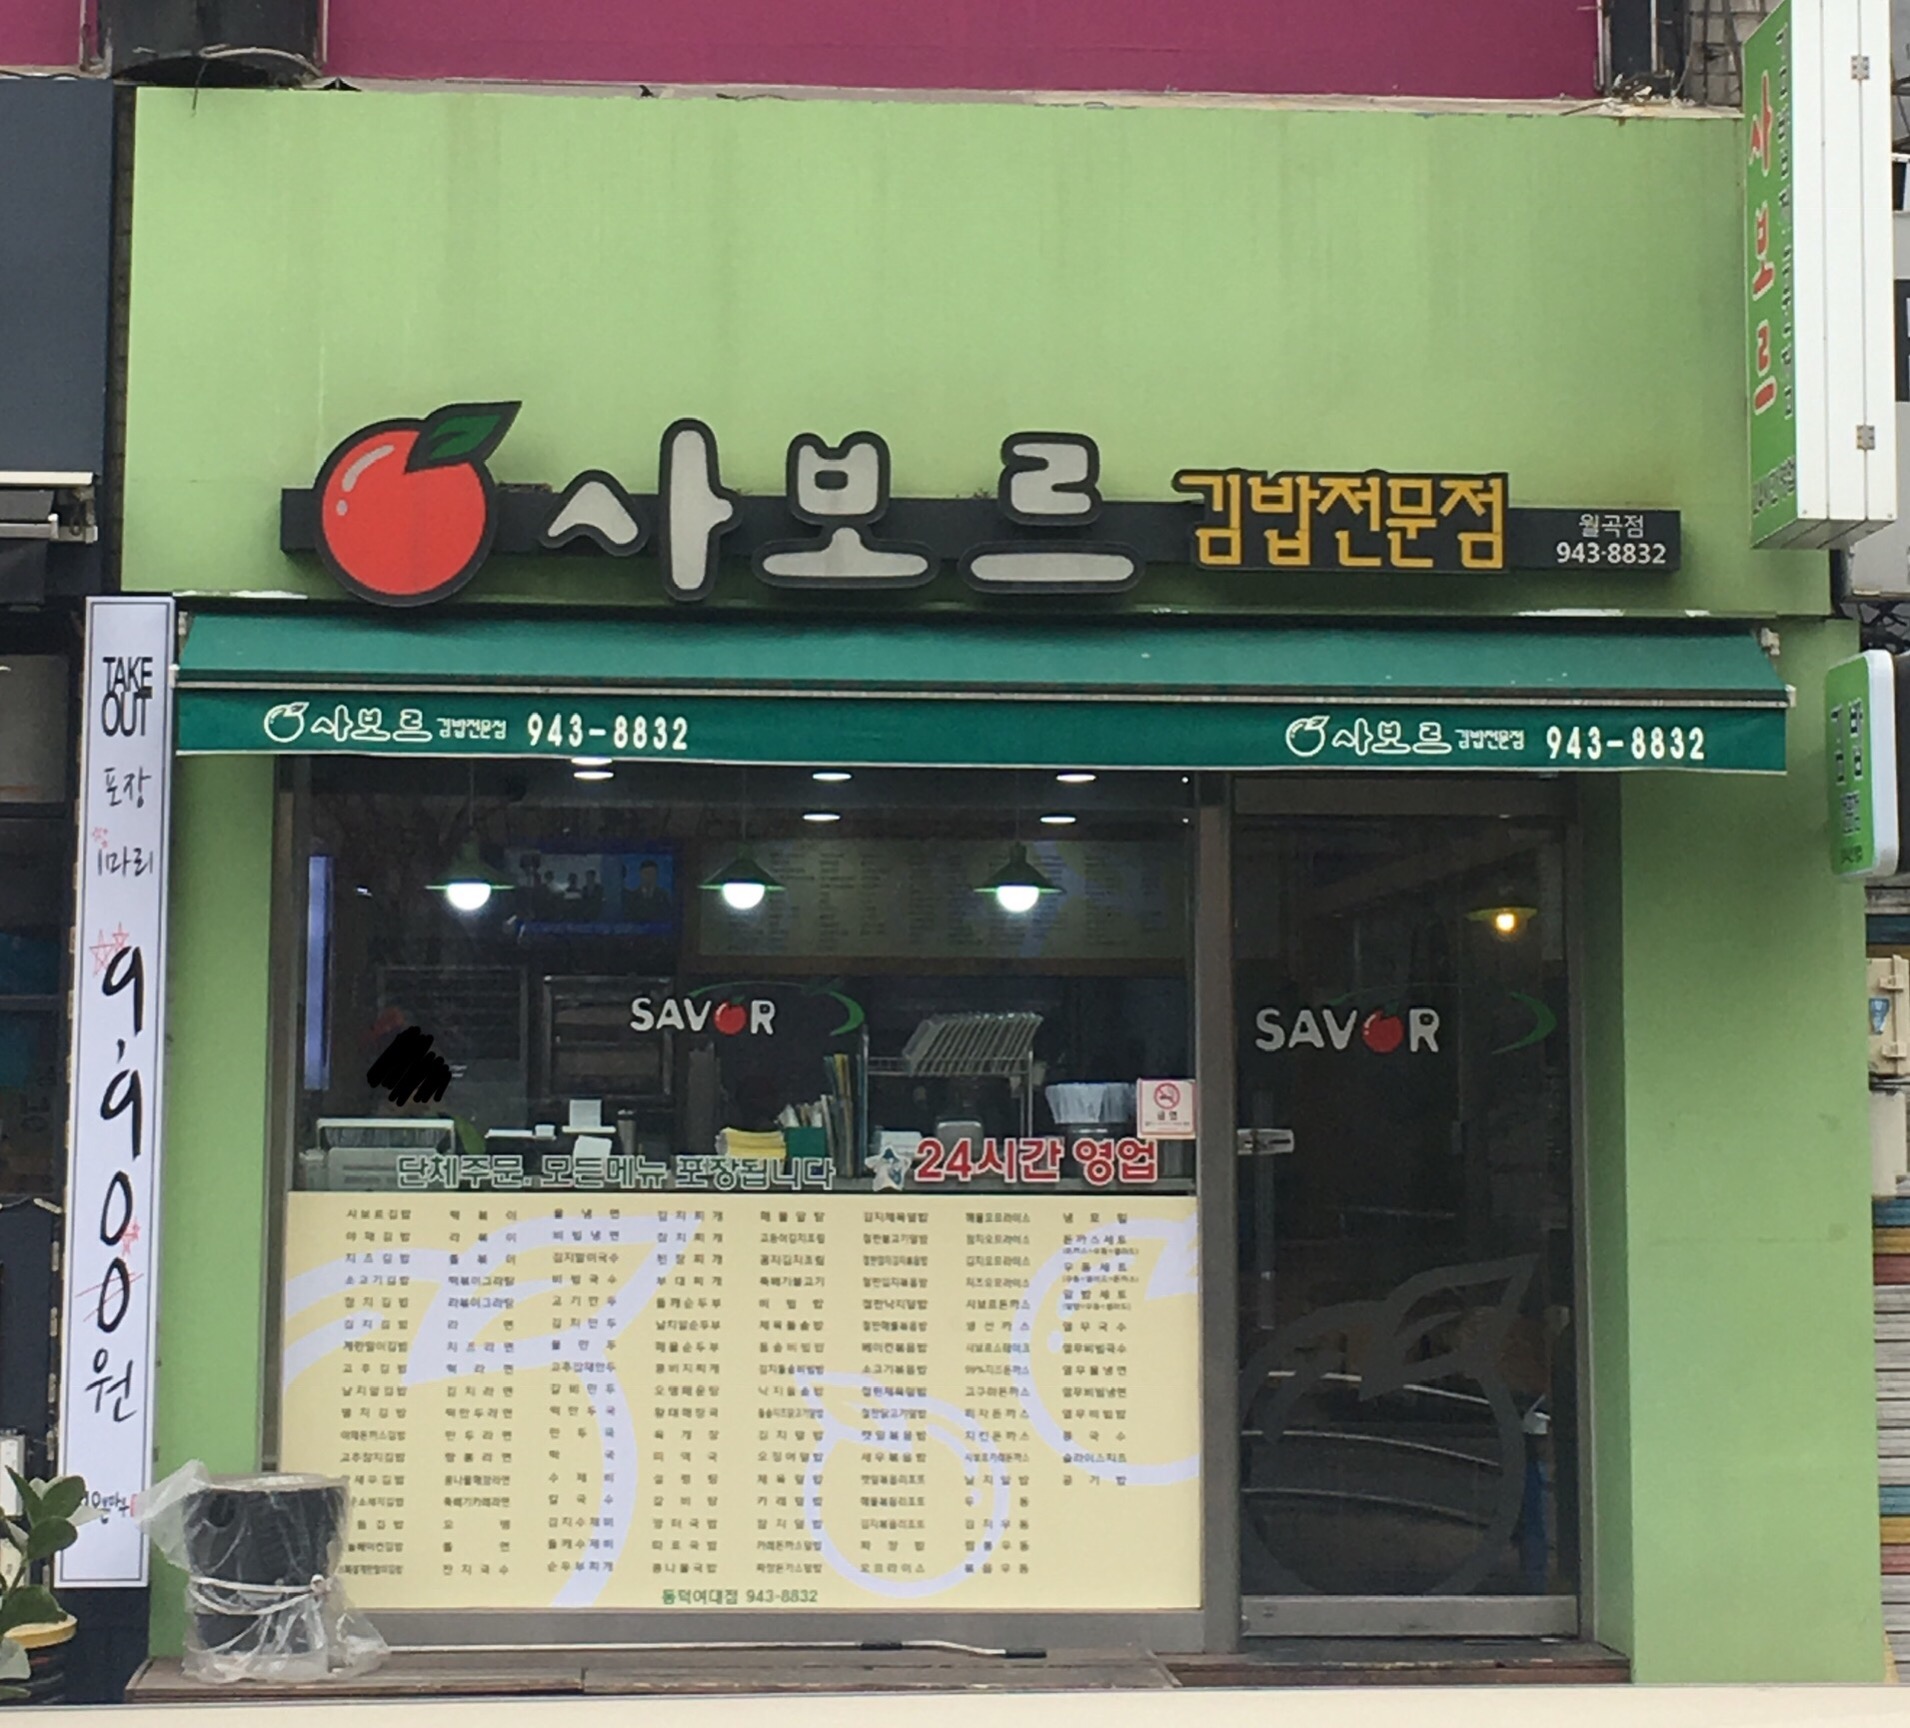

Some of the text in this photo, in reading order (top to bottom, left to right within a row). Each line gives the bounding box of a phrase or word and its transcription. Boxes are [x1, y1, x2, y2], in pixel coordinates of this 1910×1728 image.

[1748, 69, 1777, 416] 사보르
[545, 424, 1505, 594] 사보르 김밥전문점
[1579, 513, 1644, 538] 월곡점
[102, 656, 153, 698] TAKE
[101, 689, 153, 737] OUT
[310, 704, 688, 751] 사보르 김밥전문점 943-8832
[1331, 717, 1705, 761] 사보르 김밥전문점 943-8832
[103, 766, 151, 809] 포장
[98, 846, 154, 878] 1마리
[541, 1155, 669, 1189] 모든메뉴
[675, 1154, 837, 1191] 포장됩니다
[914, 1137, 1159, 1186] 24시간 영업
[662, 1590, 818, 1605] 동덕여대점 943-8832
